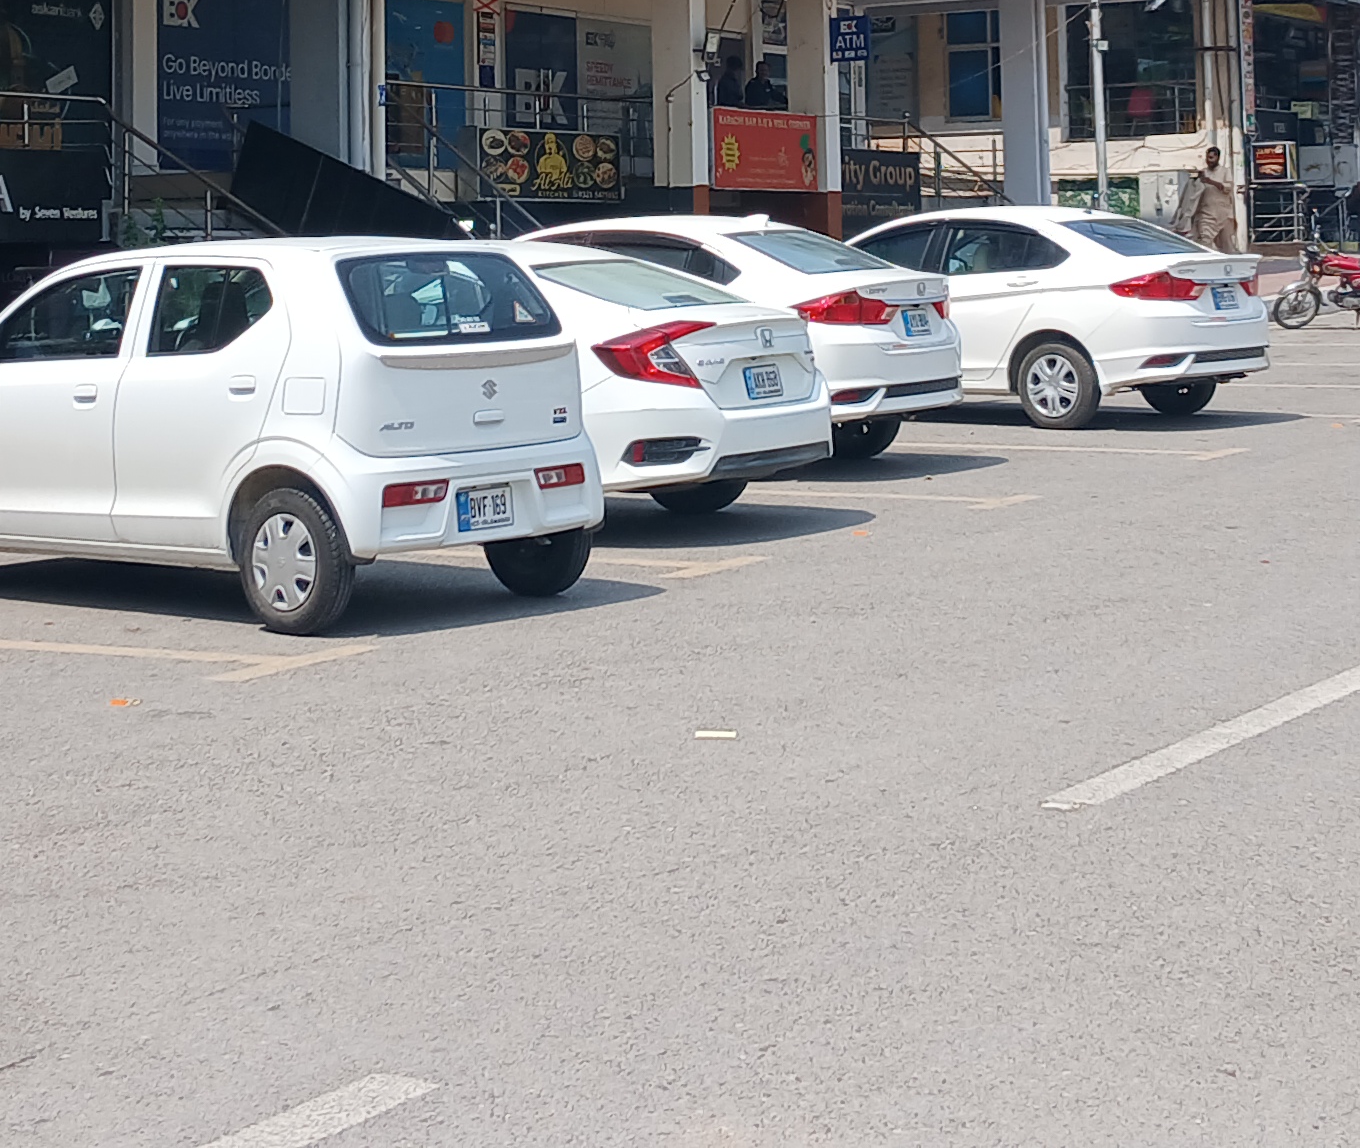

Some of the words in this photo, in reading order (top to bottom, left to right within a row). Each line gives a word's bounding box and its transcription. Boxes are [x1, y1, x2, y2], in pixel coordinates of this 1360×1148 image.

[836, 34, 865, 51] ATM
[163, 54, 186, 75] Go
[190, 56, 248, 83] Beyond
[586, 74, 632, 89] REMITTANCE
[163, 81, 192, 102] Live
[197, 83, 261, 105] Limitless
[869, 160, 915, 192] Group
[19, 206, 32, 221] by
[34, 205, 61, 219] Seven
[62, 207, 98, 219] Ventures
[379, 420, 415, 432] ALTO
